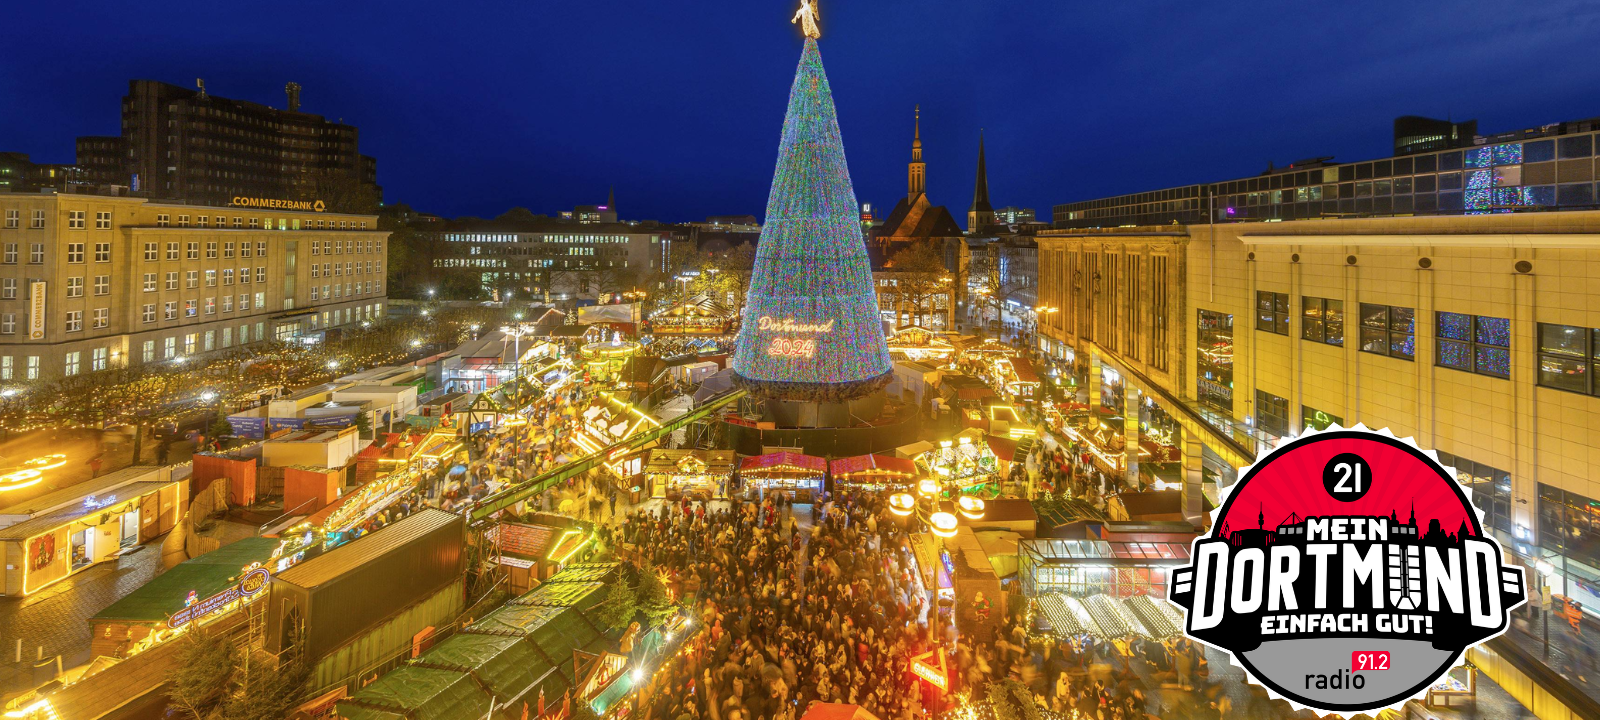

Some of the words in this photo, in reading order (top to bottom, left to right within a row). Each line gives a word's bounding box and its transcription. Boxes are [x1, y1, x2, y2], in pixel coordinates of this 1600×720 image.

[233, 197, 312, 209] COMMERZBANK
[35, 283, 43, 328] COMMERZBANK
[758, 316, 834, 332] Dortmund
[768, 338, 814, 358] 2024
